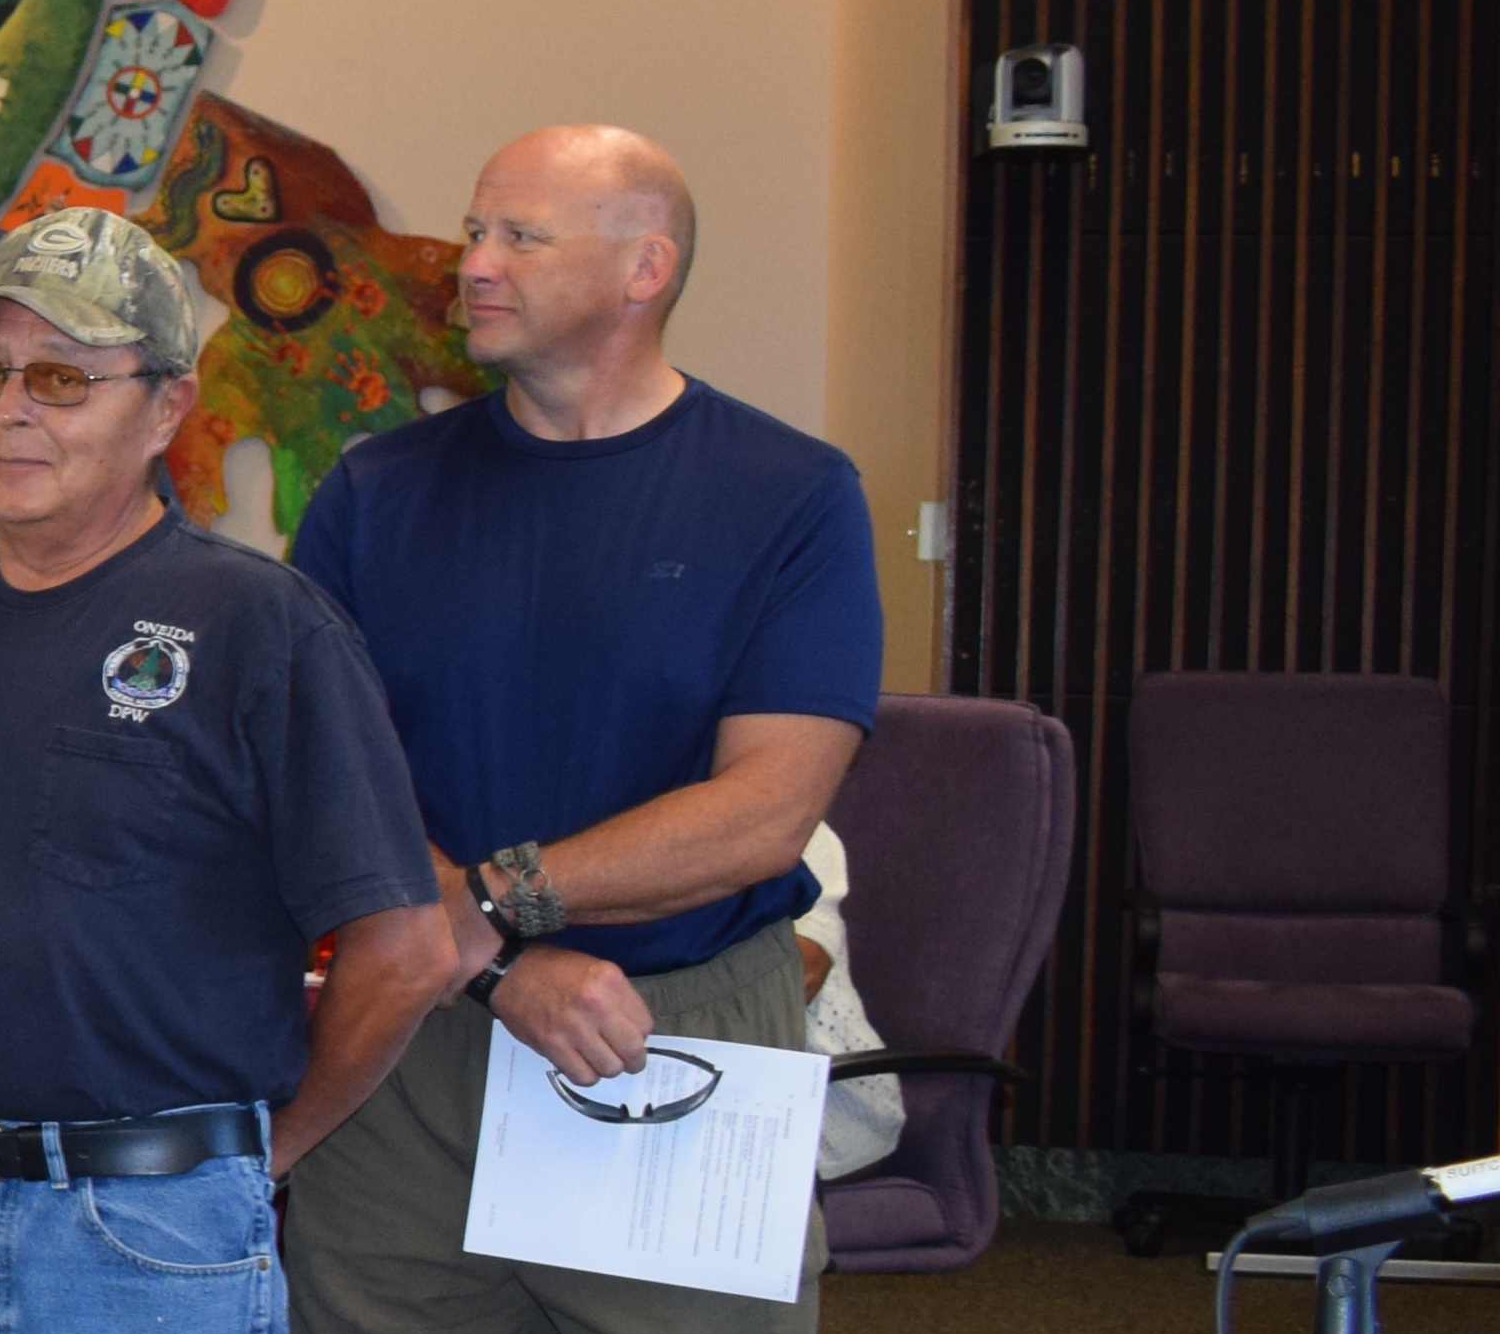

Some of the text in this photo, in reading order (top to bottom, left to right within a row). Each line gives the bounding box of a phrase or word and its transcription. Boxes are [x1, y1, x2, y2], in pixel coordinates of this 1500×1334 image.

[27, 221, 88, 255] G
[133, 620, 196, 643] ONEIDA
[107, 704, 150, 724] DPW
